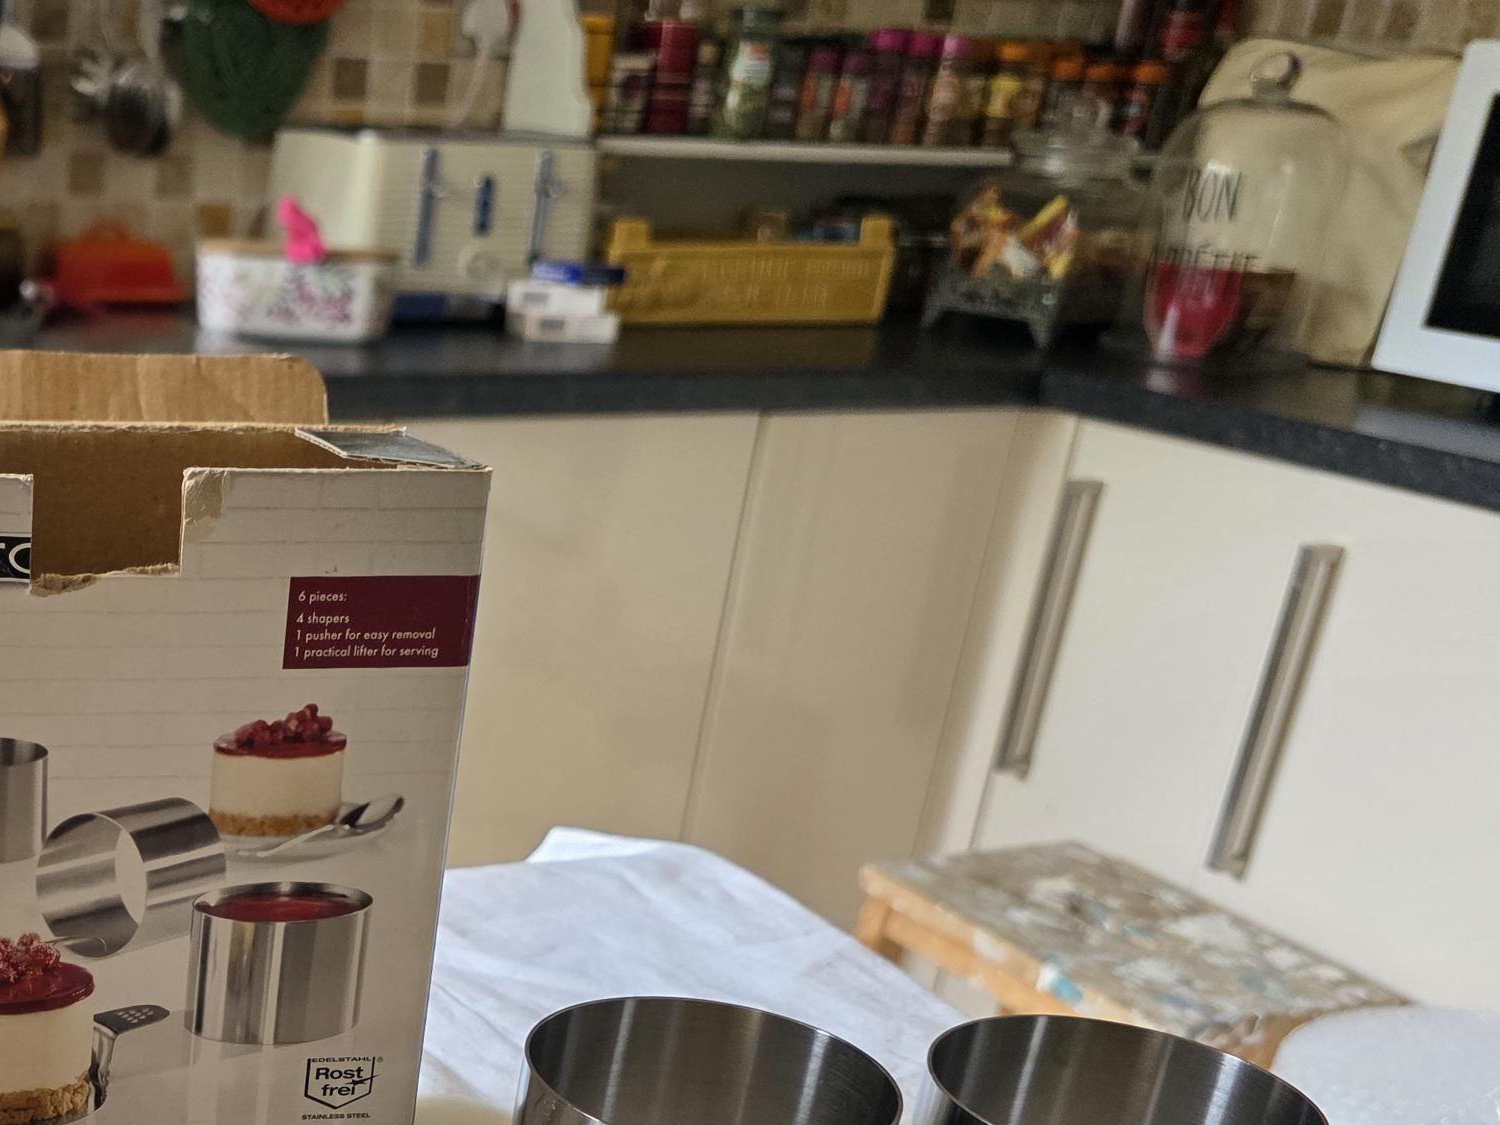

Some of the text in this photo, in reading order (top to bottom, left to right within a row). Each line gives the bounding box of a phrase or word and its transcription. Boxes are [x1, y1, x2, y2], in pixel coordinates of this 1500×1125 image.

[298, 590, 348, 604] 6 pieces:
[296, 611, 350, 626] 4 shapers
[296, 627, 436, 646] 1 pusher for easy removal
[295, 645, 439, 661] 1 practical lifter for serving
[315, 1066, 364, 1080] Rost
[321, 1083, 356, 1097] frei
[301, 1113, 345, 1121] STAINLESS
